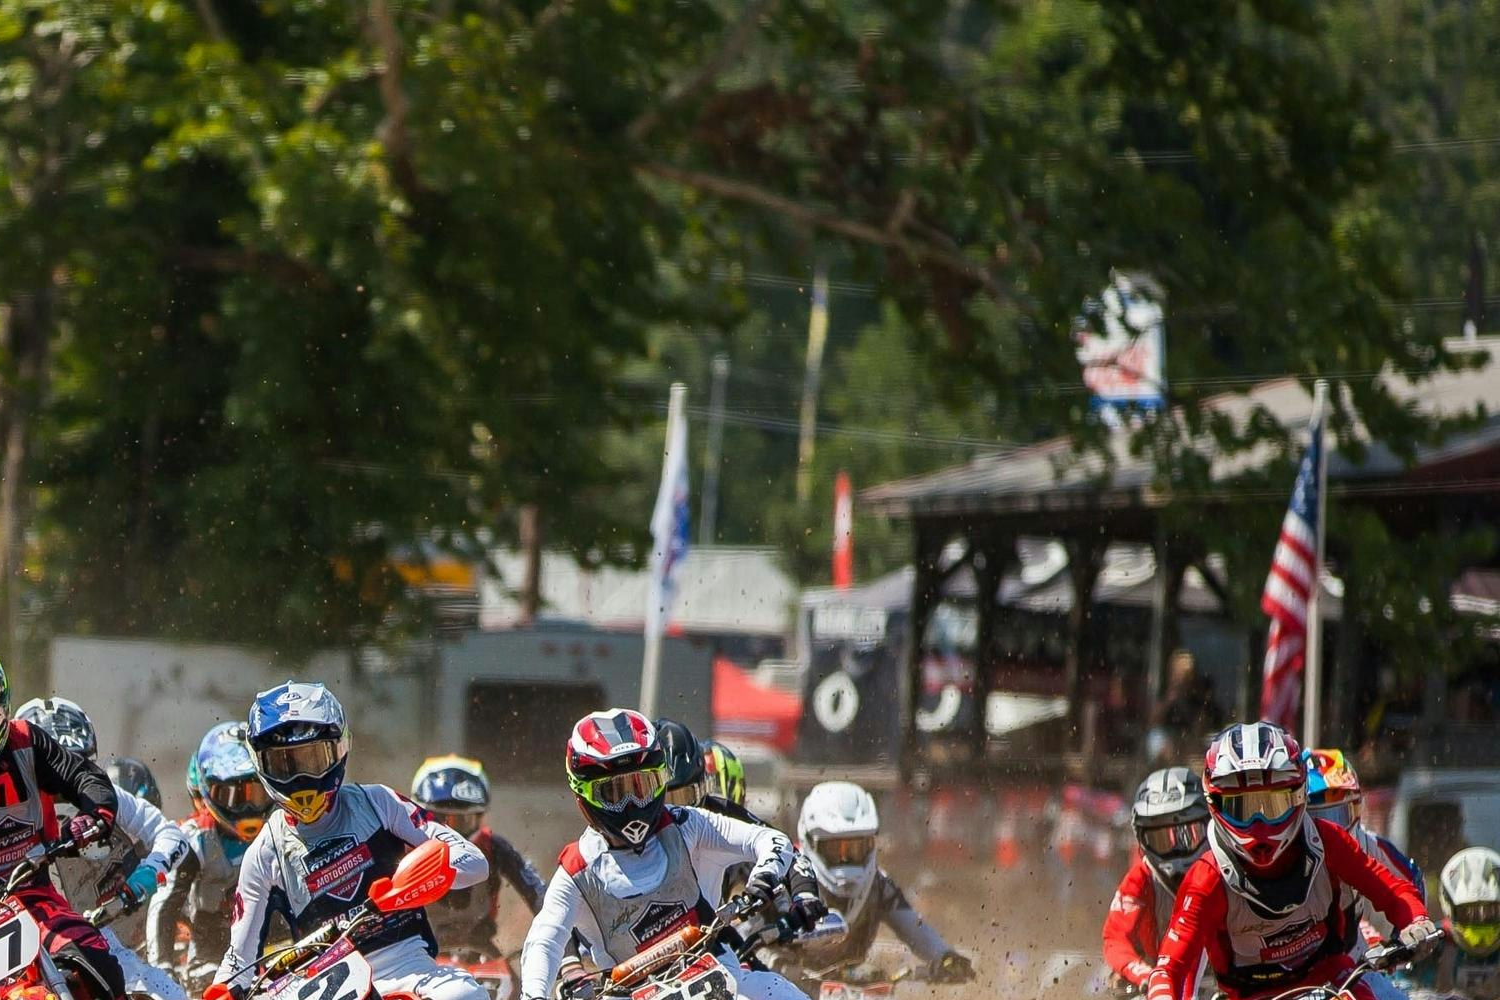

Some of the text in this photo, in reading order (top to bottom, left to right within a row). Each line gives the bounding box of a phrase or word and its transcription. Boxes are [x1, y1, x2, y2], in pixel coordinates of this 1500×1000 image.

[316, 853, 364, 888] MOTOCROSS
[393, 874, 447, 908] ACERBIS
[1271, 932, 1321, 960] MOTOCROSS
